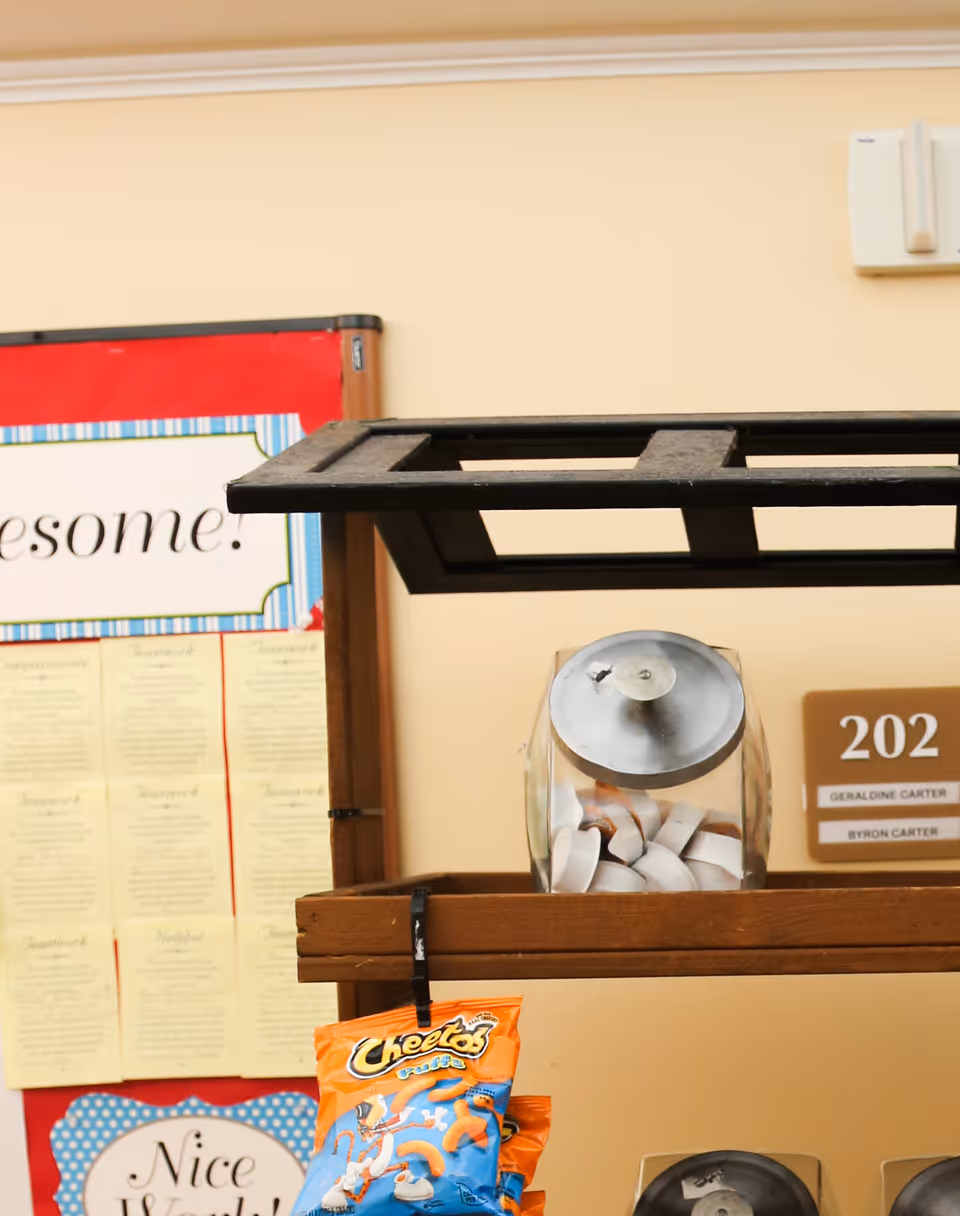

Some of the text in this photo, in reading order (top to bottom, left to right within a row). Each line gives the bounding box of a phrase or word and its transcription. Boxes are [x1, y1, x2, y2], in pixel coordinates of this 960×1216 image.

[839, 713, 939, 760] 202
[829, 788, 947, 802] GERALDINE CARTER
[847, 827, 938, 840] BYRON CARTER
[352, 1017, 494, 1076] Cheetos
[396, 1054, 466, 1080] Puffs
[127, 1129, 256, 1189] Nice
